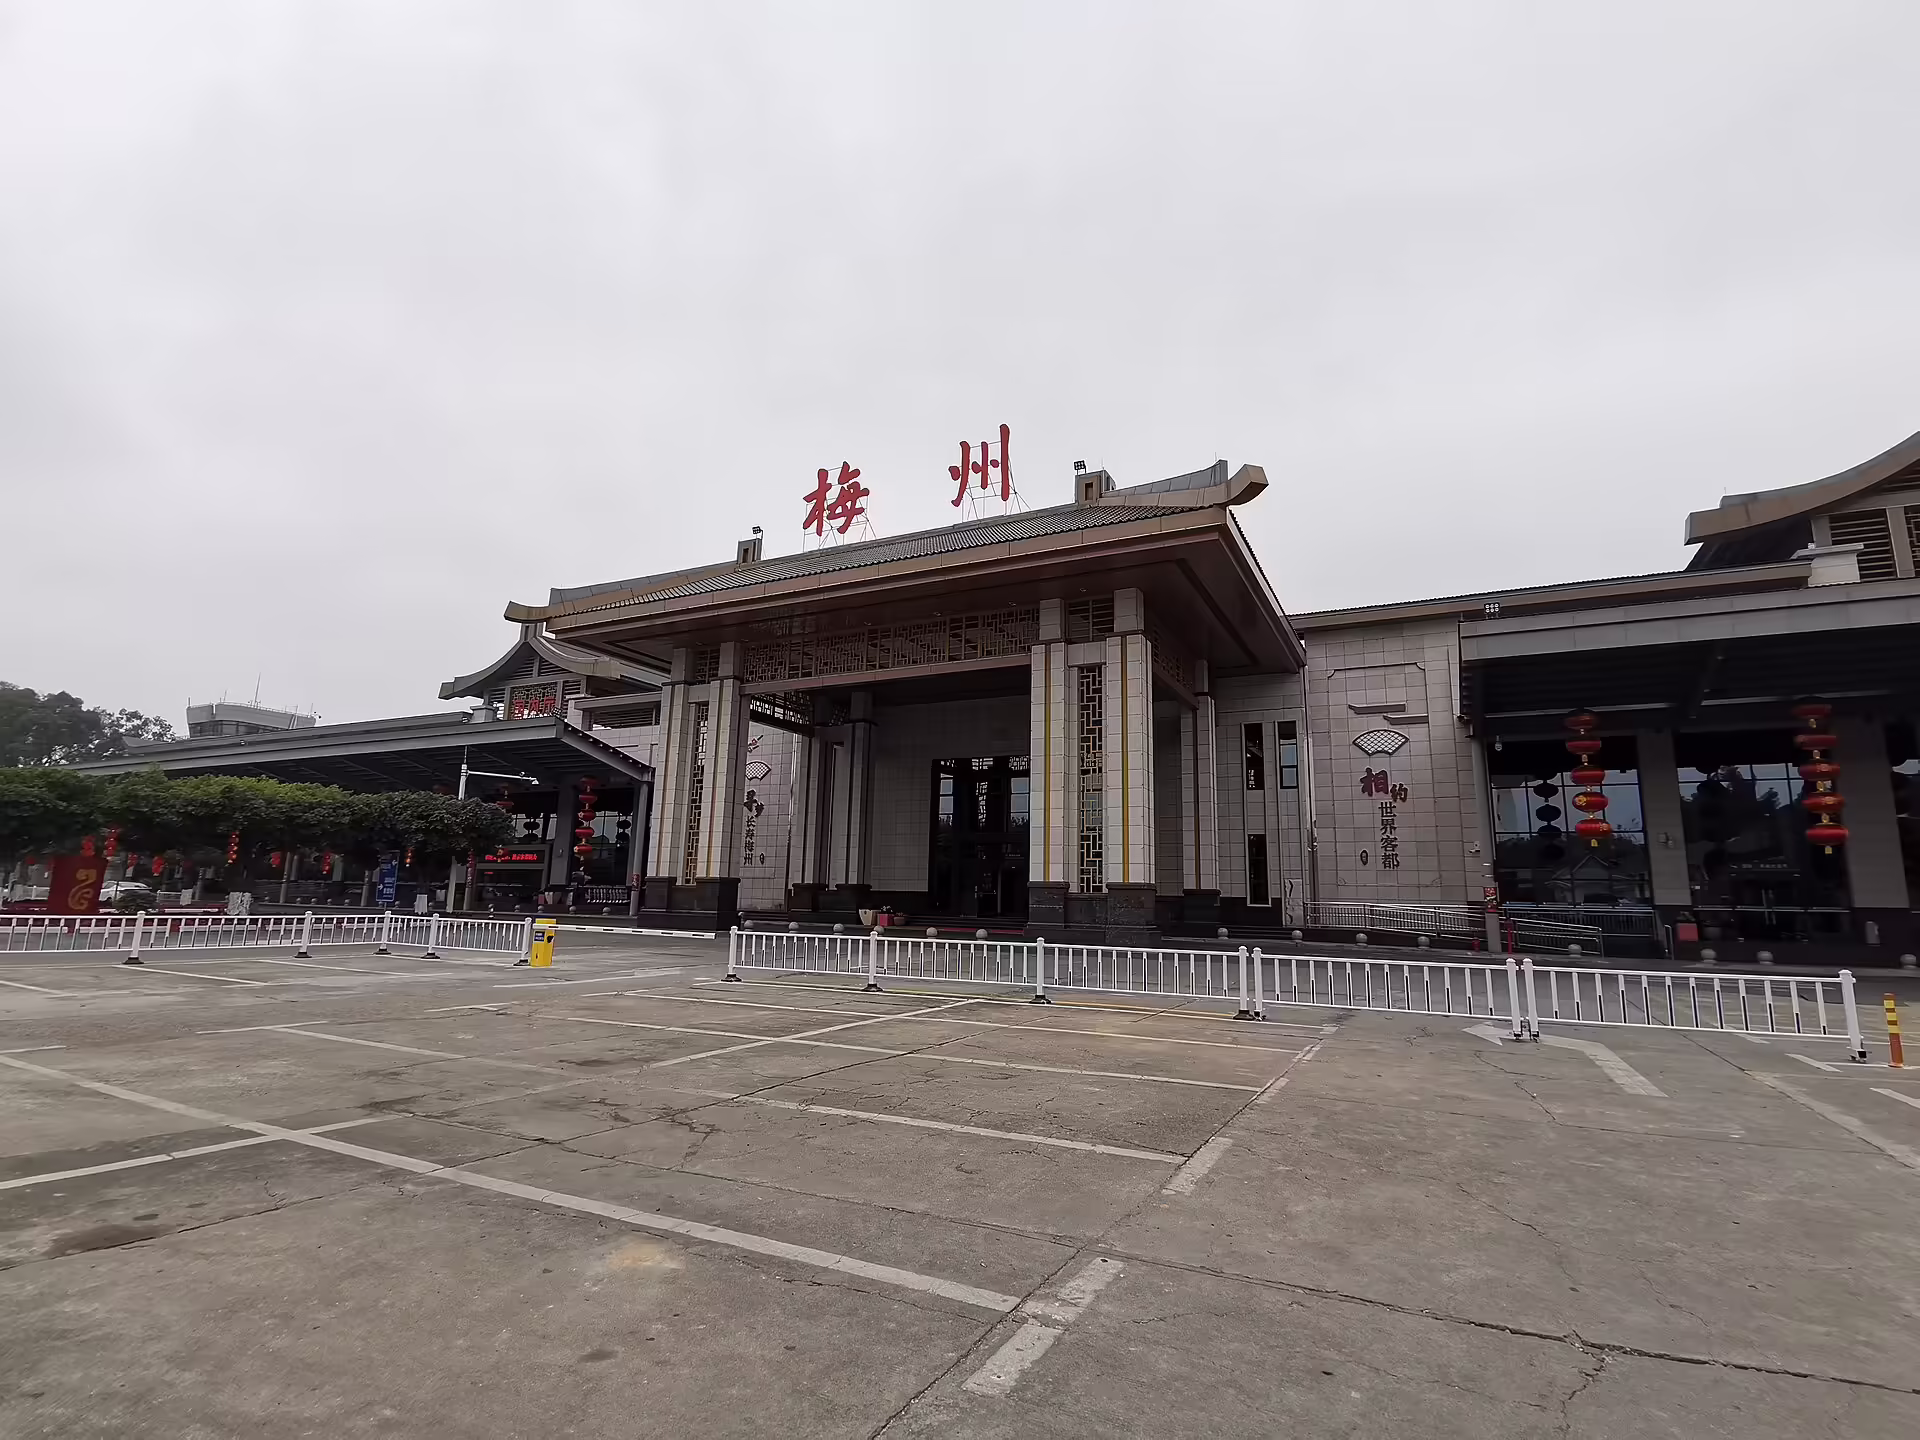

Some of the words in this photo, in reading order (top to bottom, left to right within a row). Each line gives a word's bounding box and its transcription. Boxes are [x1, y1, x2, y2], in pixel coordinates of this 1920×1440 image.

[803, 424, 1010, 536] 梅州
[1360, 767, 1408, 802] 相约
[1378, 801, 1400, 869] 世界客都
